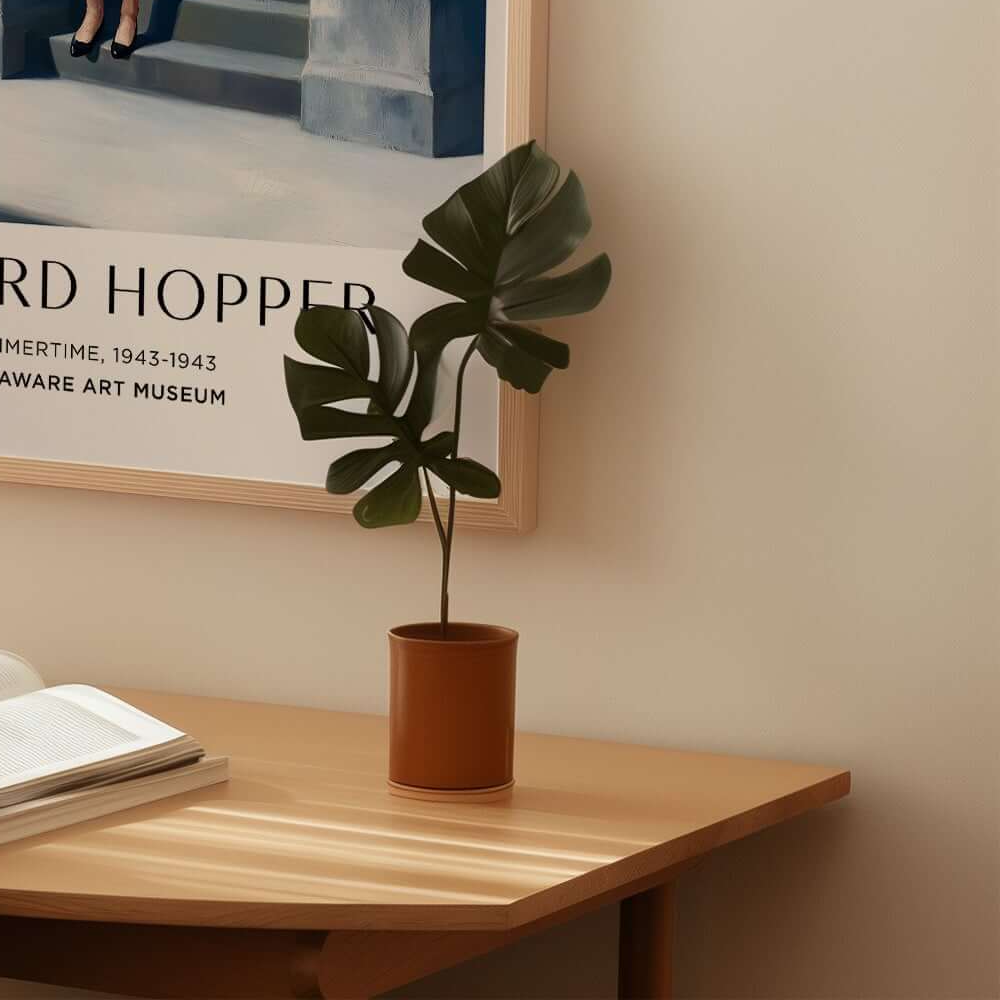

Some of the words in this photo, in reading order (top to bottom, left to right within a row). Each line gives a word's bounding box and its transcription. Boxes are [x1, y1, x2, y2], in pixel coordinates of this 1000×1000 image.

[112, 347, 217, 372] 1943-1943
[82, 377, 126, 397] ART
[133, 381, 226, 406] MUSEUM
